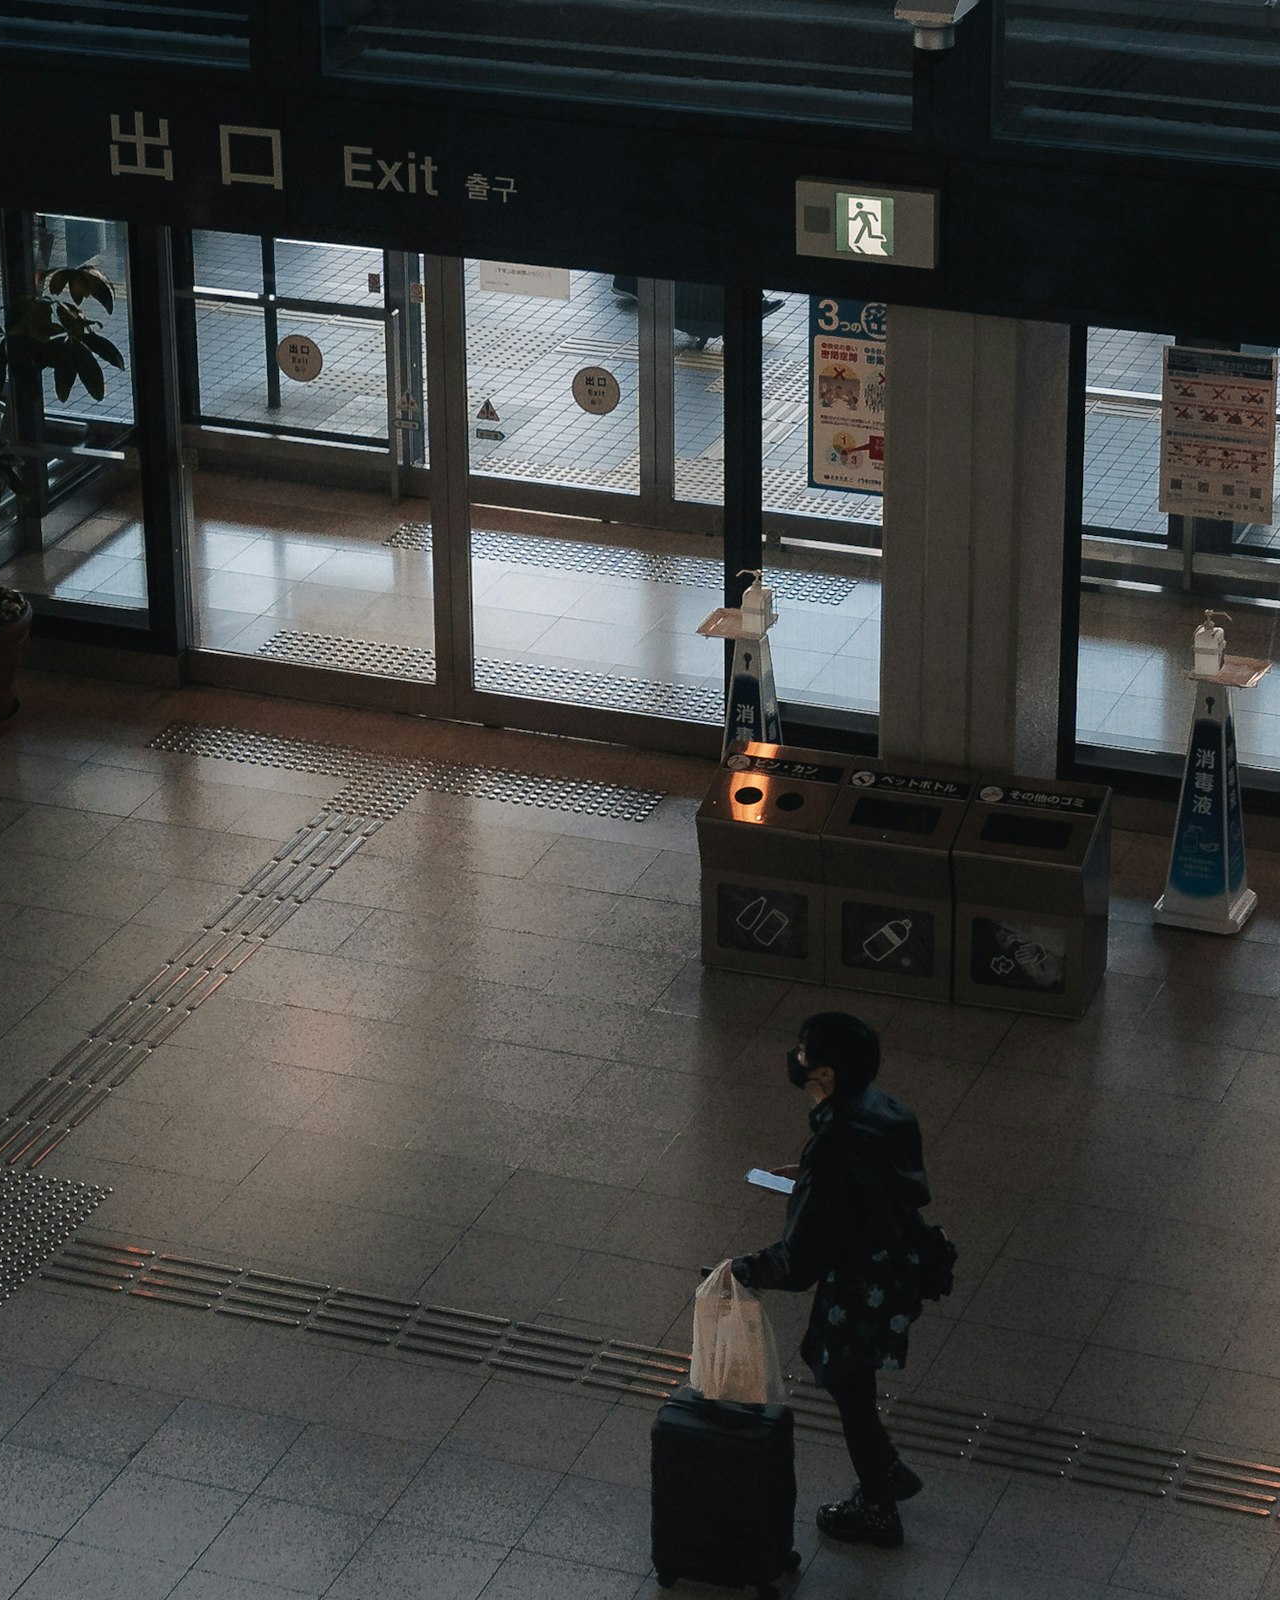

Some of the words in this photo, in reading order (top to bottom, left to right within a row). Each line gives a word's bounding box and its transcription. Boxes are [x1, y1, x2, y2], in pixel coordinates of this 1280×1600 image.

[110, 111, 283, 190] 出口
[342, 145, 439, 197] Exit
[464, 172, 518, 204] 출구
[289, 344, 309, 355] 出口
[585, 376, 607, 386] 出口
[587, 389, 606, 398] Exit
[830, 452, 838, 463] 2
[850, 455, 858, 465] 3
[754, 758, 819, 776] ビン・カン
[881, 775, 958, 794] ペットボトル
[1191, 748, 1217, 817] 消毒液
[1009, 790, 1088, 809] その他のゴミ
